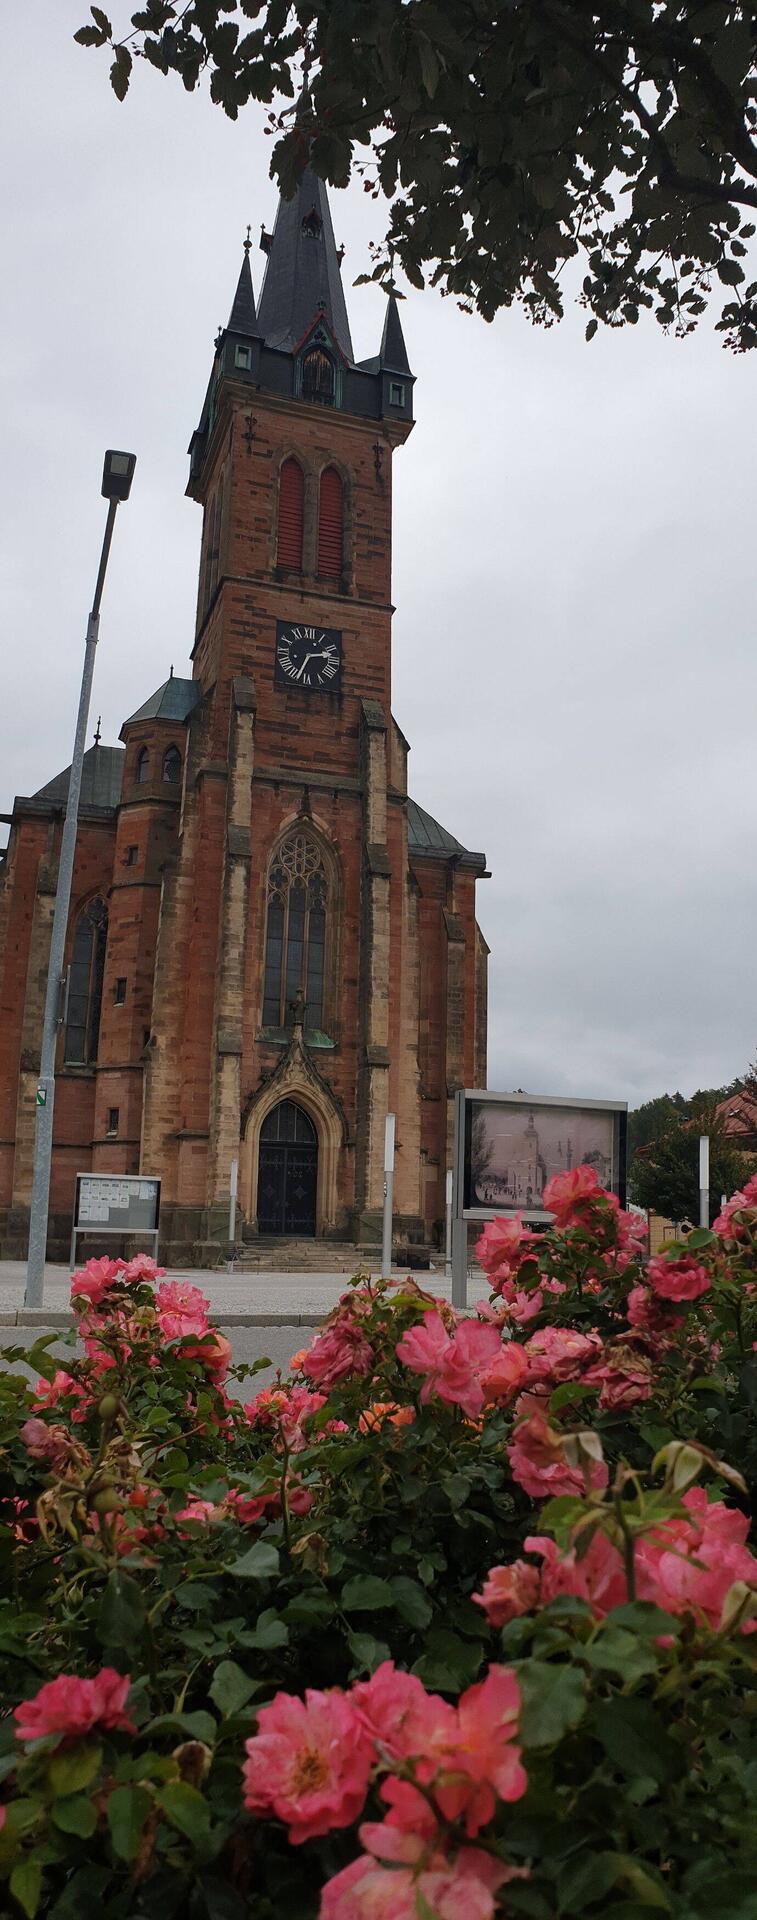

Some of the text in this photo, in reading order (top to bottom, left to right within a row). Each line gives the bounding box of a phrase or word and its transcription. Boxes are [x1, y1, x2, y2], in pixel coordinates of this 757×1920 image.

[291, 628, 302, 640] XI
[304, 627, 316, 639] XII
[318, 634, 325, 642] I
[281, 635, 292, 645] X
[277, 646, 290, 656] IX
[325, 644, 337, 652] II
[328, 656, 340, 666] III
[322, 664, 337, 679] IIII
[303, 674, 312, 685] VI
[317, 674, 324, 684] V
